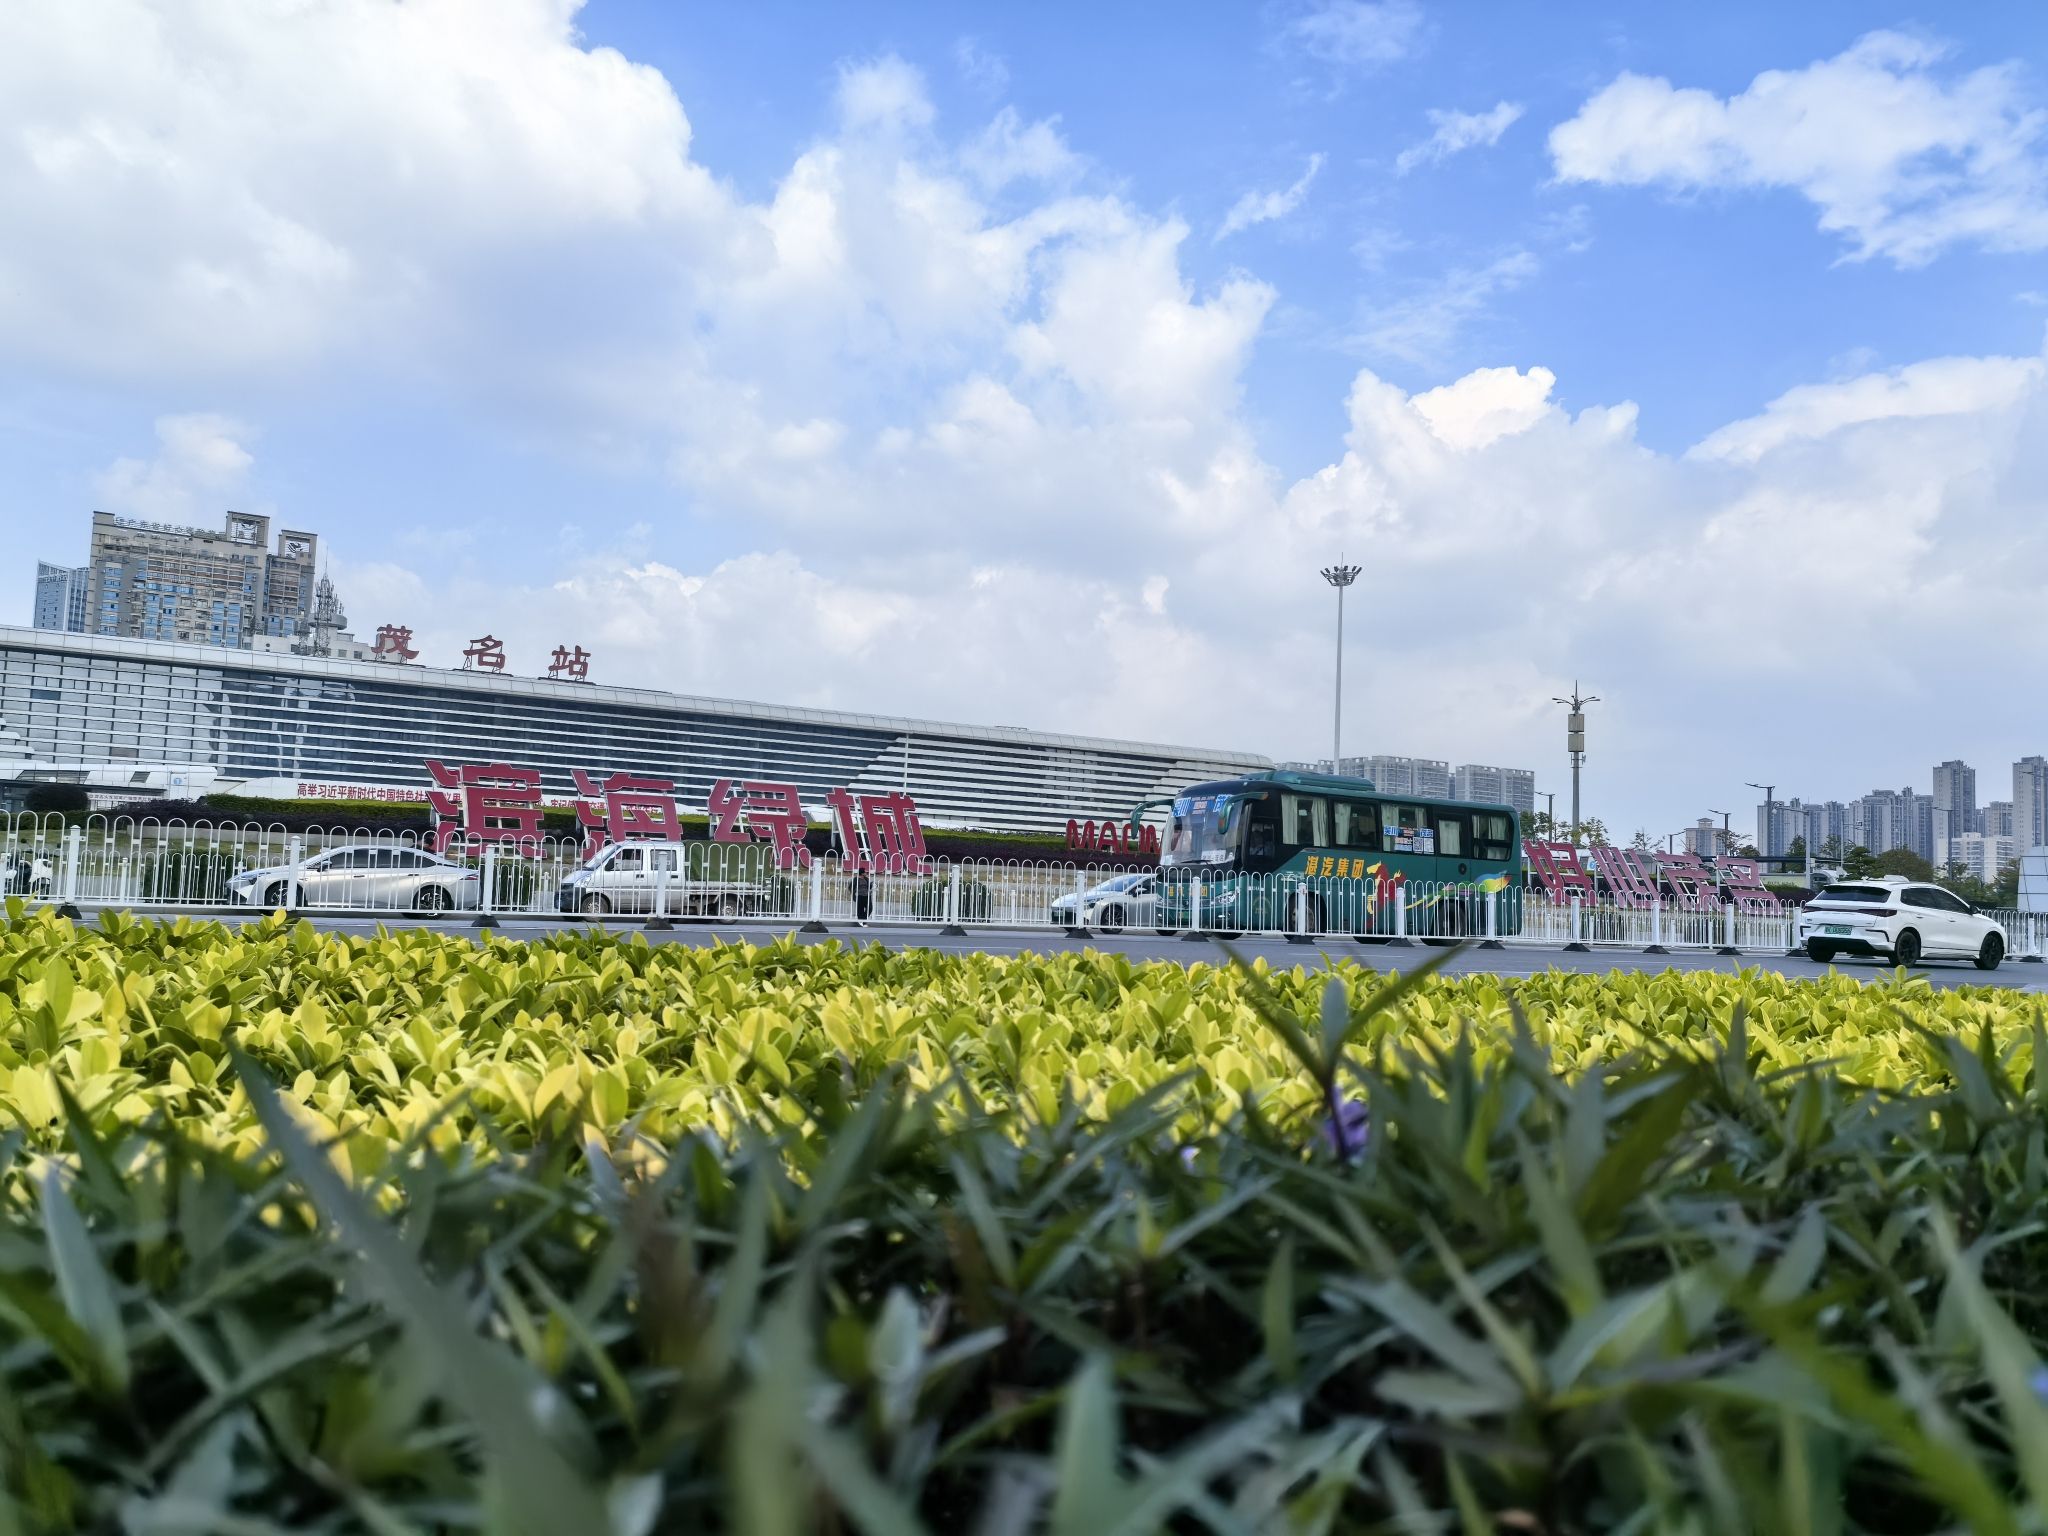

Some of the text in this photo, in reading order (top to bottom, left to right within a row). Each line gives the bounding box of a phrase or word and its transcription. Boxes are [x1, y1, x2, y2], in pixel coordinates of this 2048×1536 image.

[371, 623, 591, 676] 茂名站
[424, 759, 934, 875] 滨海绿城
[1304, 855, 1365, 878] 湛汽集团
